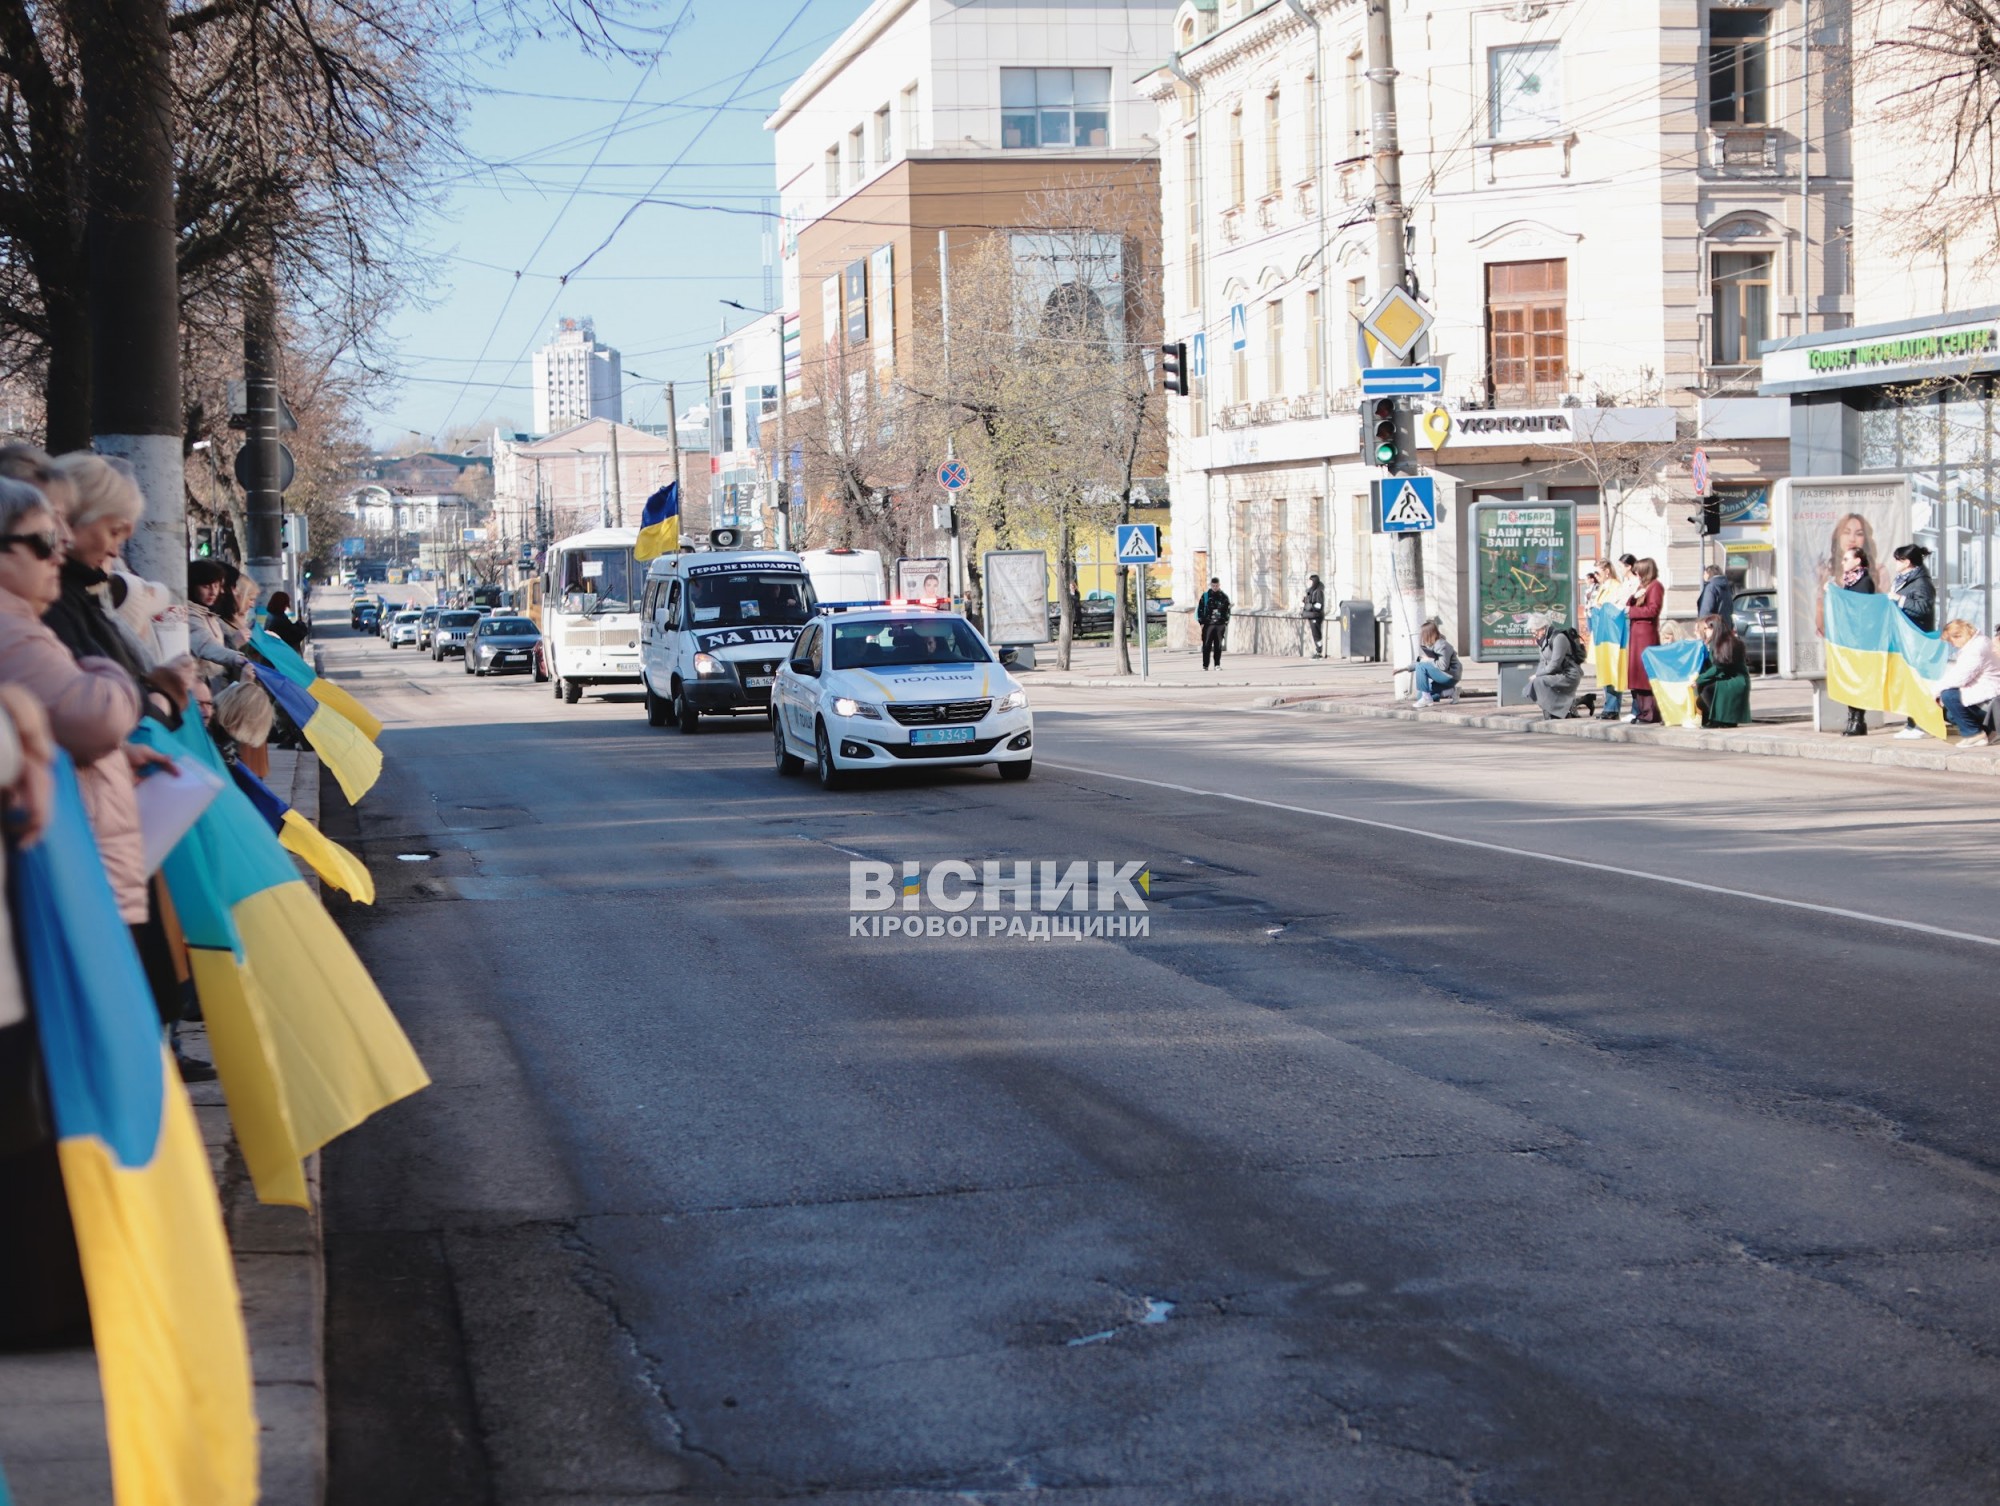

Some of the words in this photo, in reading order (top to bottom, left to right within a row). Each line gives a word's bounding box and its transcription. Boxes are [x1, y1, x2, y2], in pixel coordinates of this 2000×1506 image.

[1807, 349, 1851, 370] TOURIST
[1855, 336, 1938, 364] INFORMATION
[1941, 328, 1991, 352] CENTER
[1456, 414, 1572, 434] УКРПОШТА
[1800, 489, 1844, 498] ЛАЗЕРНА
[1848, 489, 1895, 497] ЕПІЛЯЦІЯ
[1501, 511, 1552, 523] ЛОМБАРД
[1488, 528, 1521, 537] ВАШІ
[1486, 538, 1519, 547] ВАШІ
[1524, 537, 1564, 547] ГРОШІ
[690, 564, 721, 575] ГЕРОЇ
[740, 562, 800, 571] ВМИРАЮТЬ
[894, 675, 974, 685] ПОЛІЦІЯ
[938, 728, 969, 741] 9345
